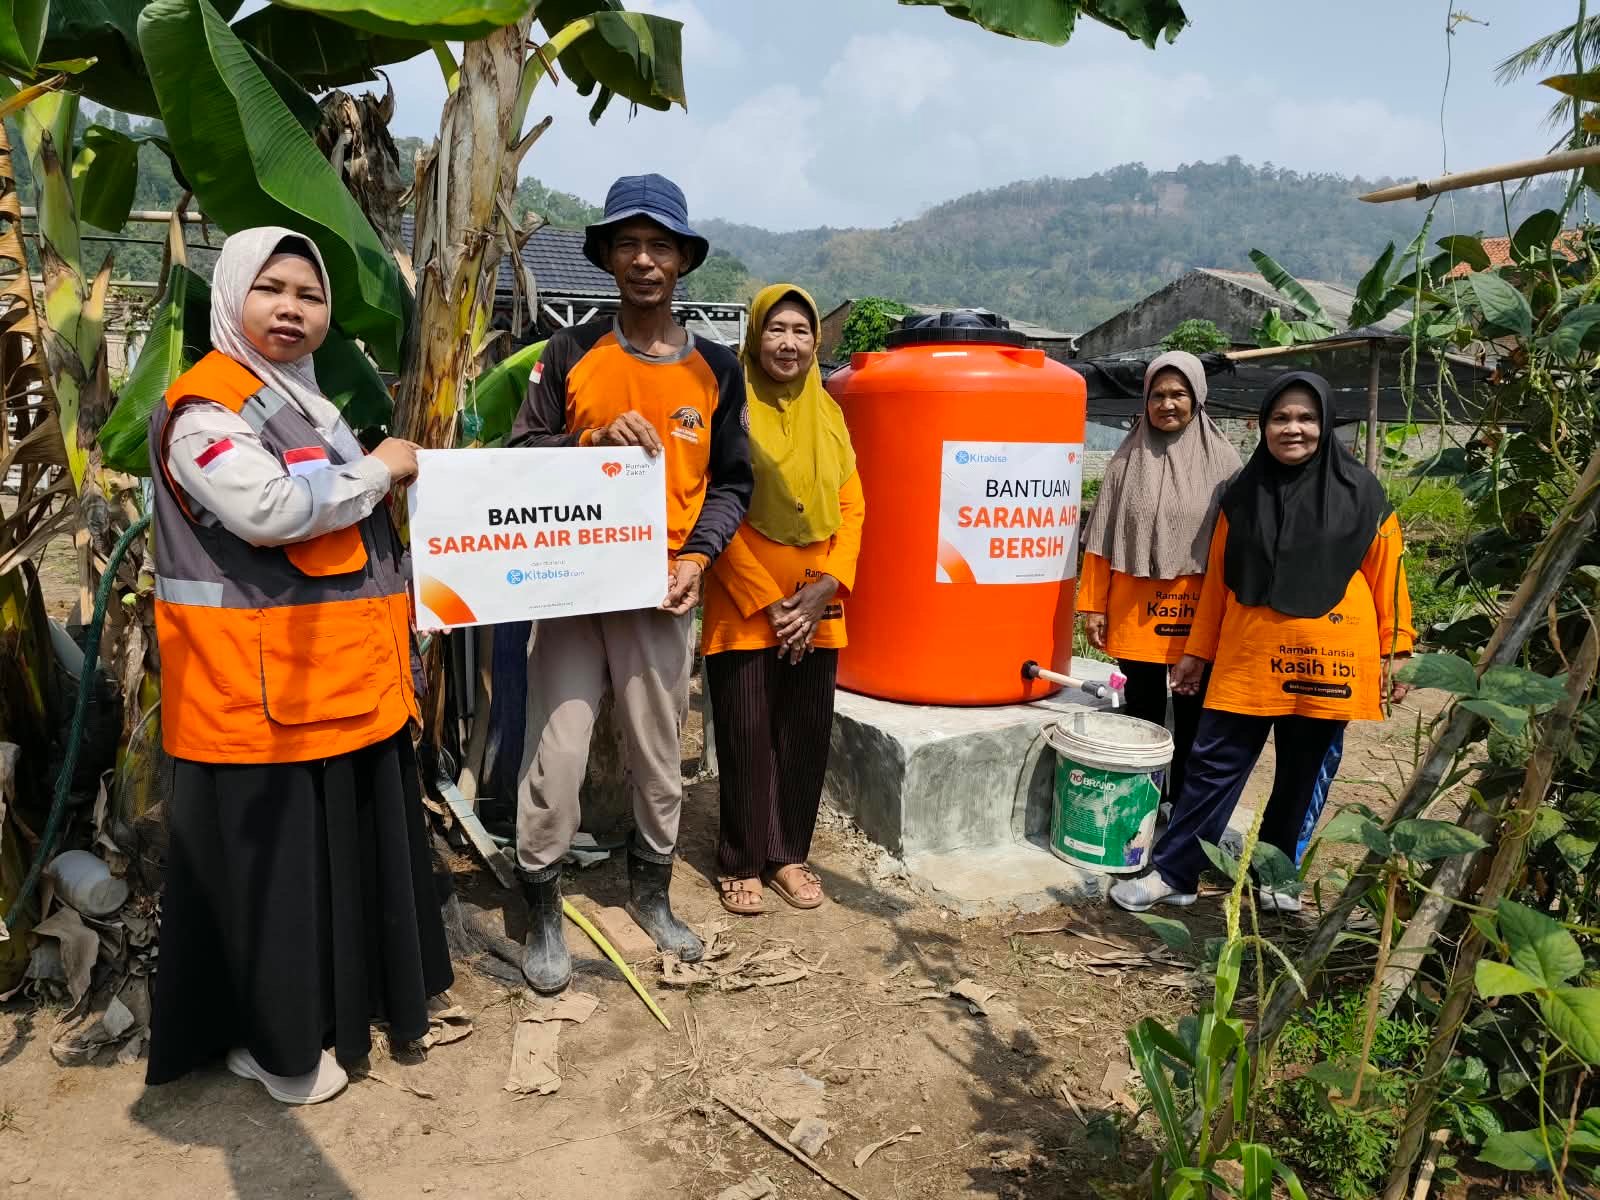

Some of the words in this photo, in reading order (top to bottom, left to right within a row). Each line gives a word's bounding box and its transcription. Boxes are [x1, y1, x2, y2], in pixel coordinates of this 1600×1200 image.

[970, 454, 1007, 463] Kitabisa
[986, 479, 1071, 498] BANTUAN
[488, 504, 602, 526] BANTUAN
[957, 505, 1056, 529] SARANA
[1058, 505, 1078, 527] AIR
[428, 532, 528, 555] SARANA
[534, 530, 572, 548] AIR
[578, 524, 652, 545] BERSIH
[989, 535, 1064, 559] BERSIH
[1156, 591, 1190, 601] Ramah
[1147, 601, 1195, 618] Kasih
[1279, 645, 1318, 656] Ramah
[1321, 647, 1355, 658] Lansia
[1270, 657, 1324, 676] Kasih
[1083, 777, 1116, 791] BRAND
